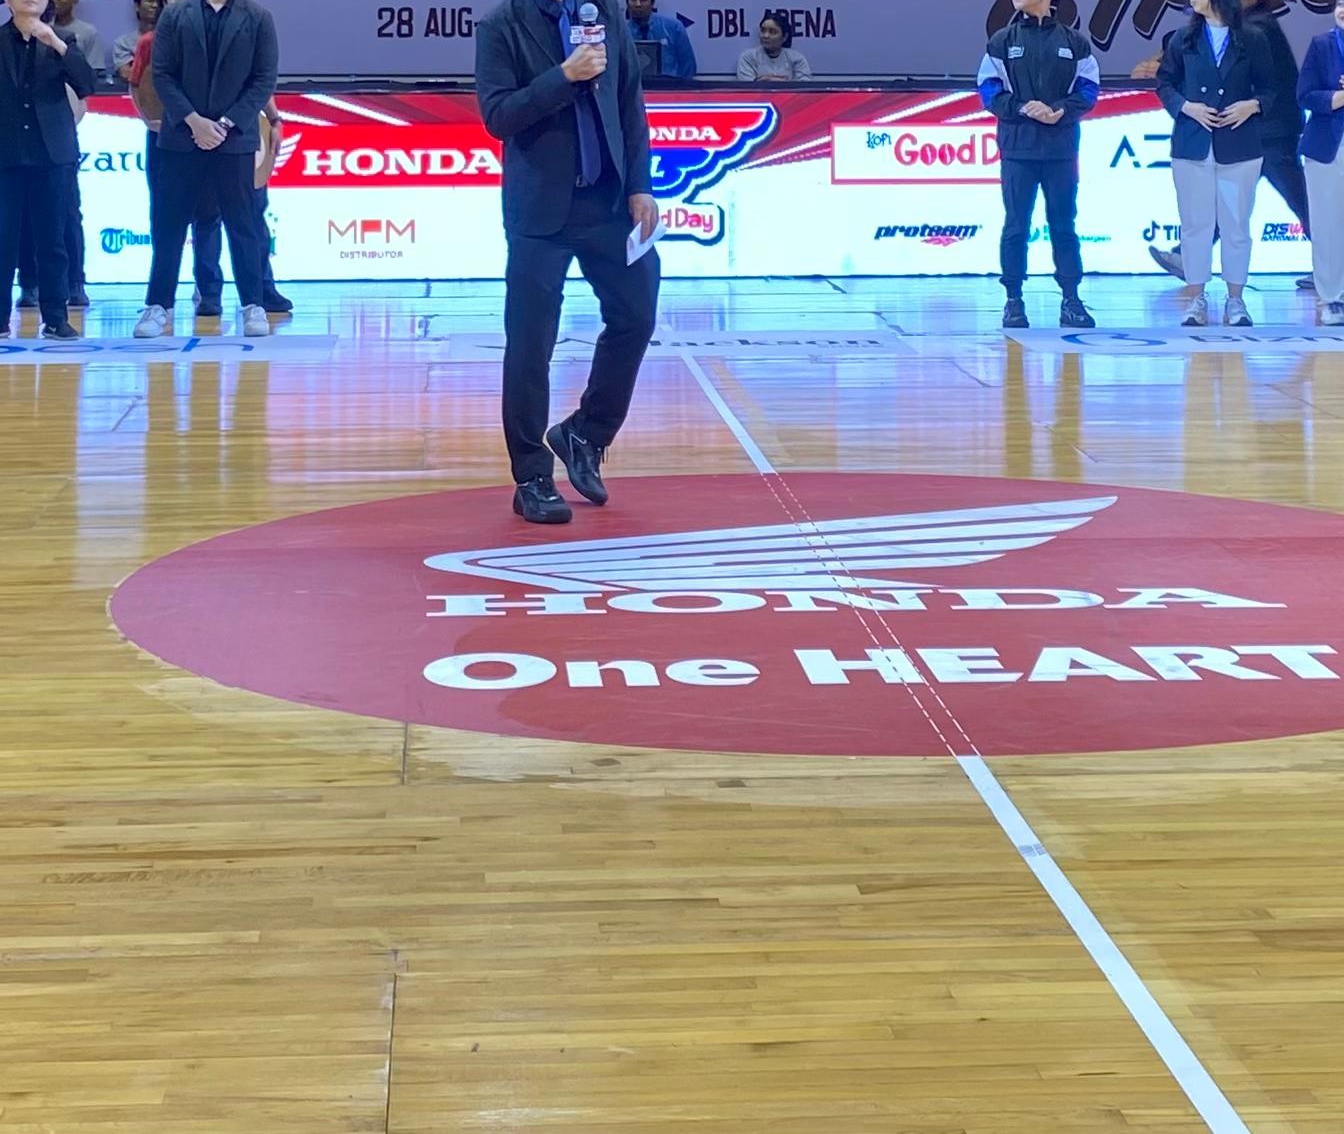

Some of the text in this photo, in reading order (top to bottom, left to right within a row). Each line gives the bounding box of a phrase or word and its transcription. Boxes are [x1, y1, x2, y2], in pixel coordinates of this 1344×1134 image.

[376, 8, 413, 38] 28
[707, 8, 750, 38] DBL
[302, 149, 503, 176] HONDA
[894, 133, 976, 166] Good
[328, 219, 415, 244] MPM
[674, 207, 714, 233] Day
[873, 223, 979, 241] proteam
[340, 250, 403, 259] DISTRIBUTOR
[426, 586, 1288, 618] HONDA
[422, 653, 761, 691] One
